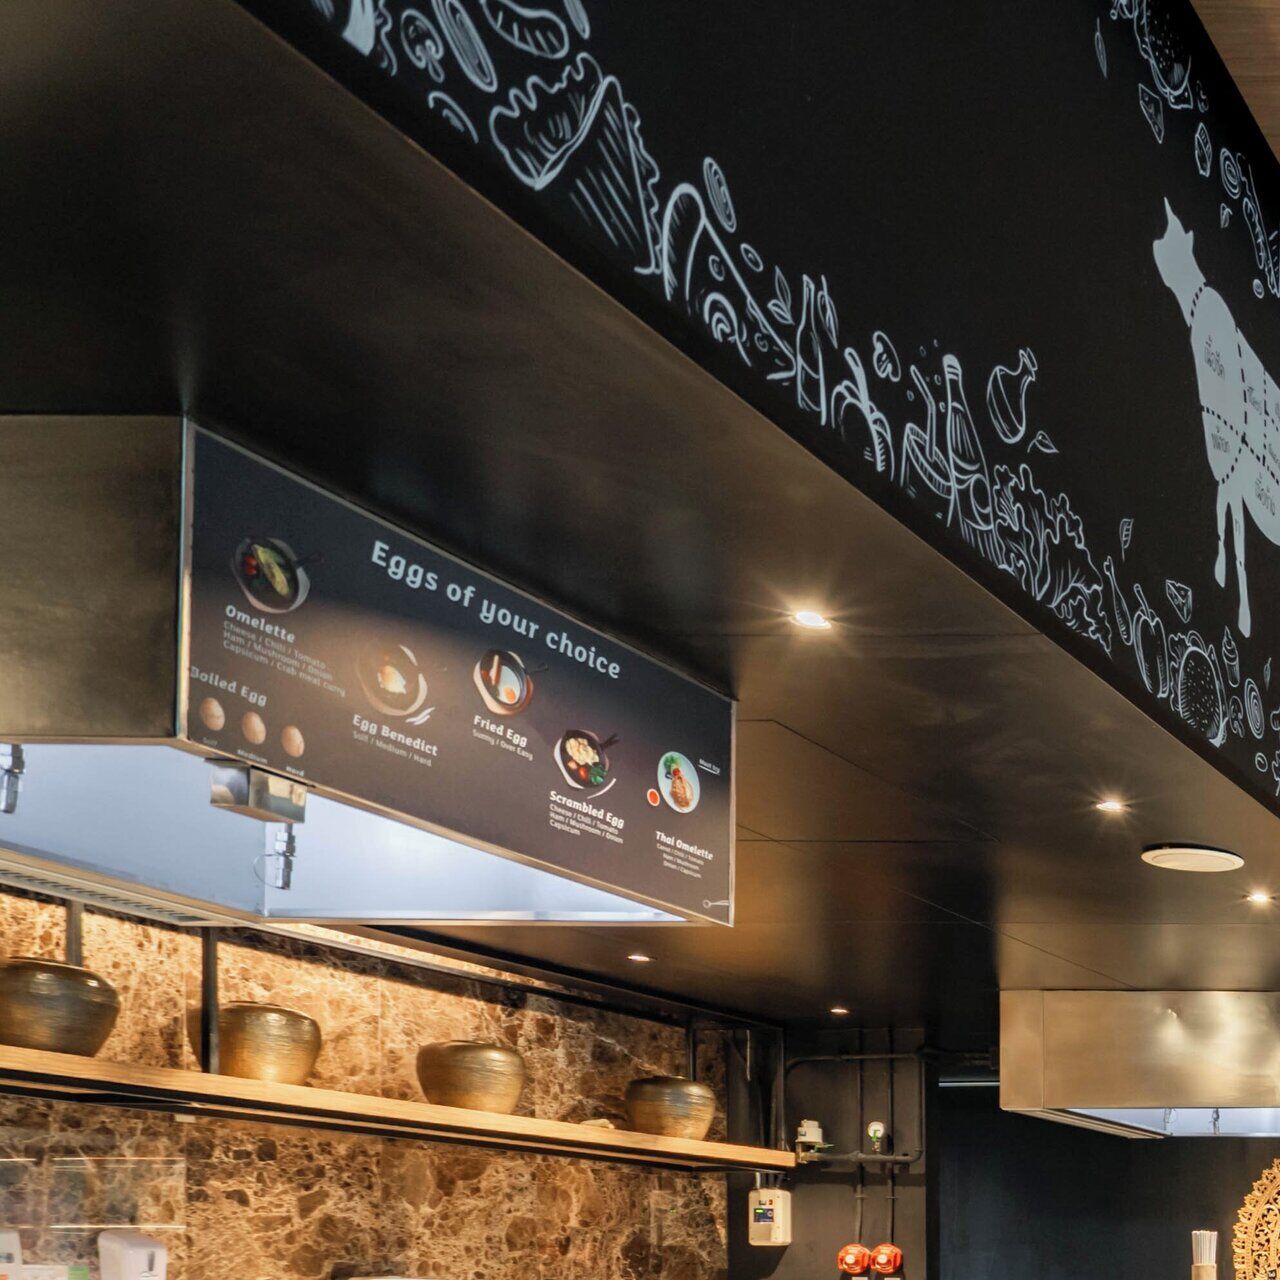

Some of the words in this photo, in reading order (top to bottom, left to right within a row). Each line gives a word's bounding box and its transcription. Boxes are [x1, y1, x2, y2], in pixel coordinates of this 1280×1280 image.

[225, 605, 296, 643] Omelette
[371, 540, 438, 591] Eggs
[446, 583, 476, 607] of
[479, 599, 540, 639] your
[545, 631, 621, 679] choice
[223, 631, 245, 646] Ham
[223, 639, 268, 665] Capsicum
[189, 666, 236, 693] Boiled
[240, 685, 268, 707] Egg
[352, 714, 378, 735] Egg
[381, 725, 438, 757] Benedict
[473, 715, 504, 735] Fried
[506, 728, 528, 748] Egg
[549, 790, 604, 819] Scrambled
[606, 811, 625, 829] Egg
[655, 830, 675, 846] Thai
[675, 839, 713, 860] Omelette
